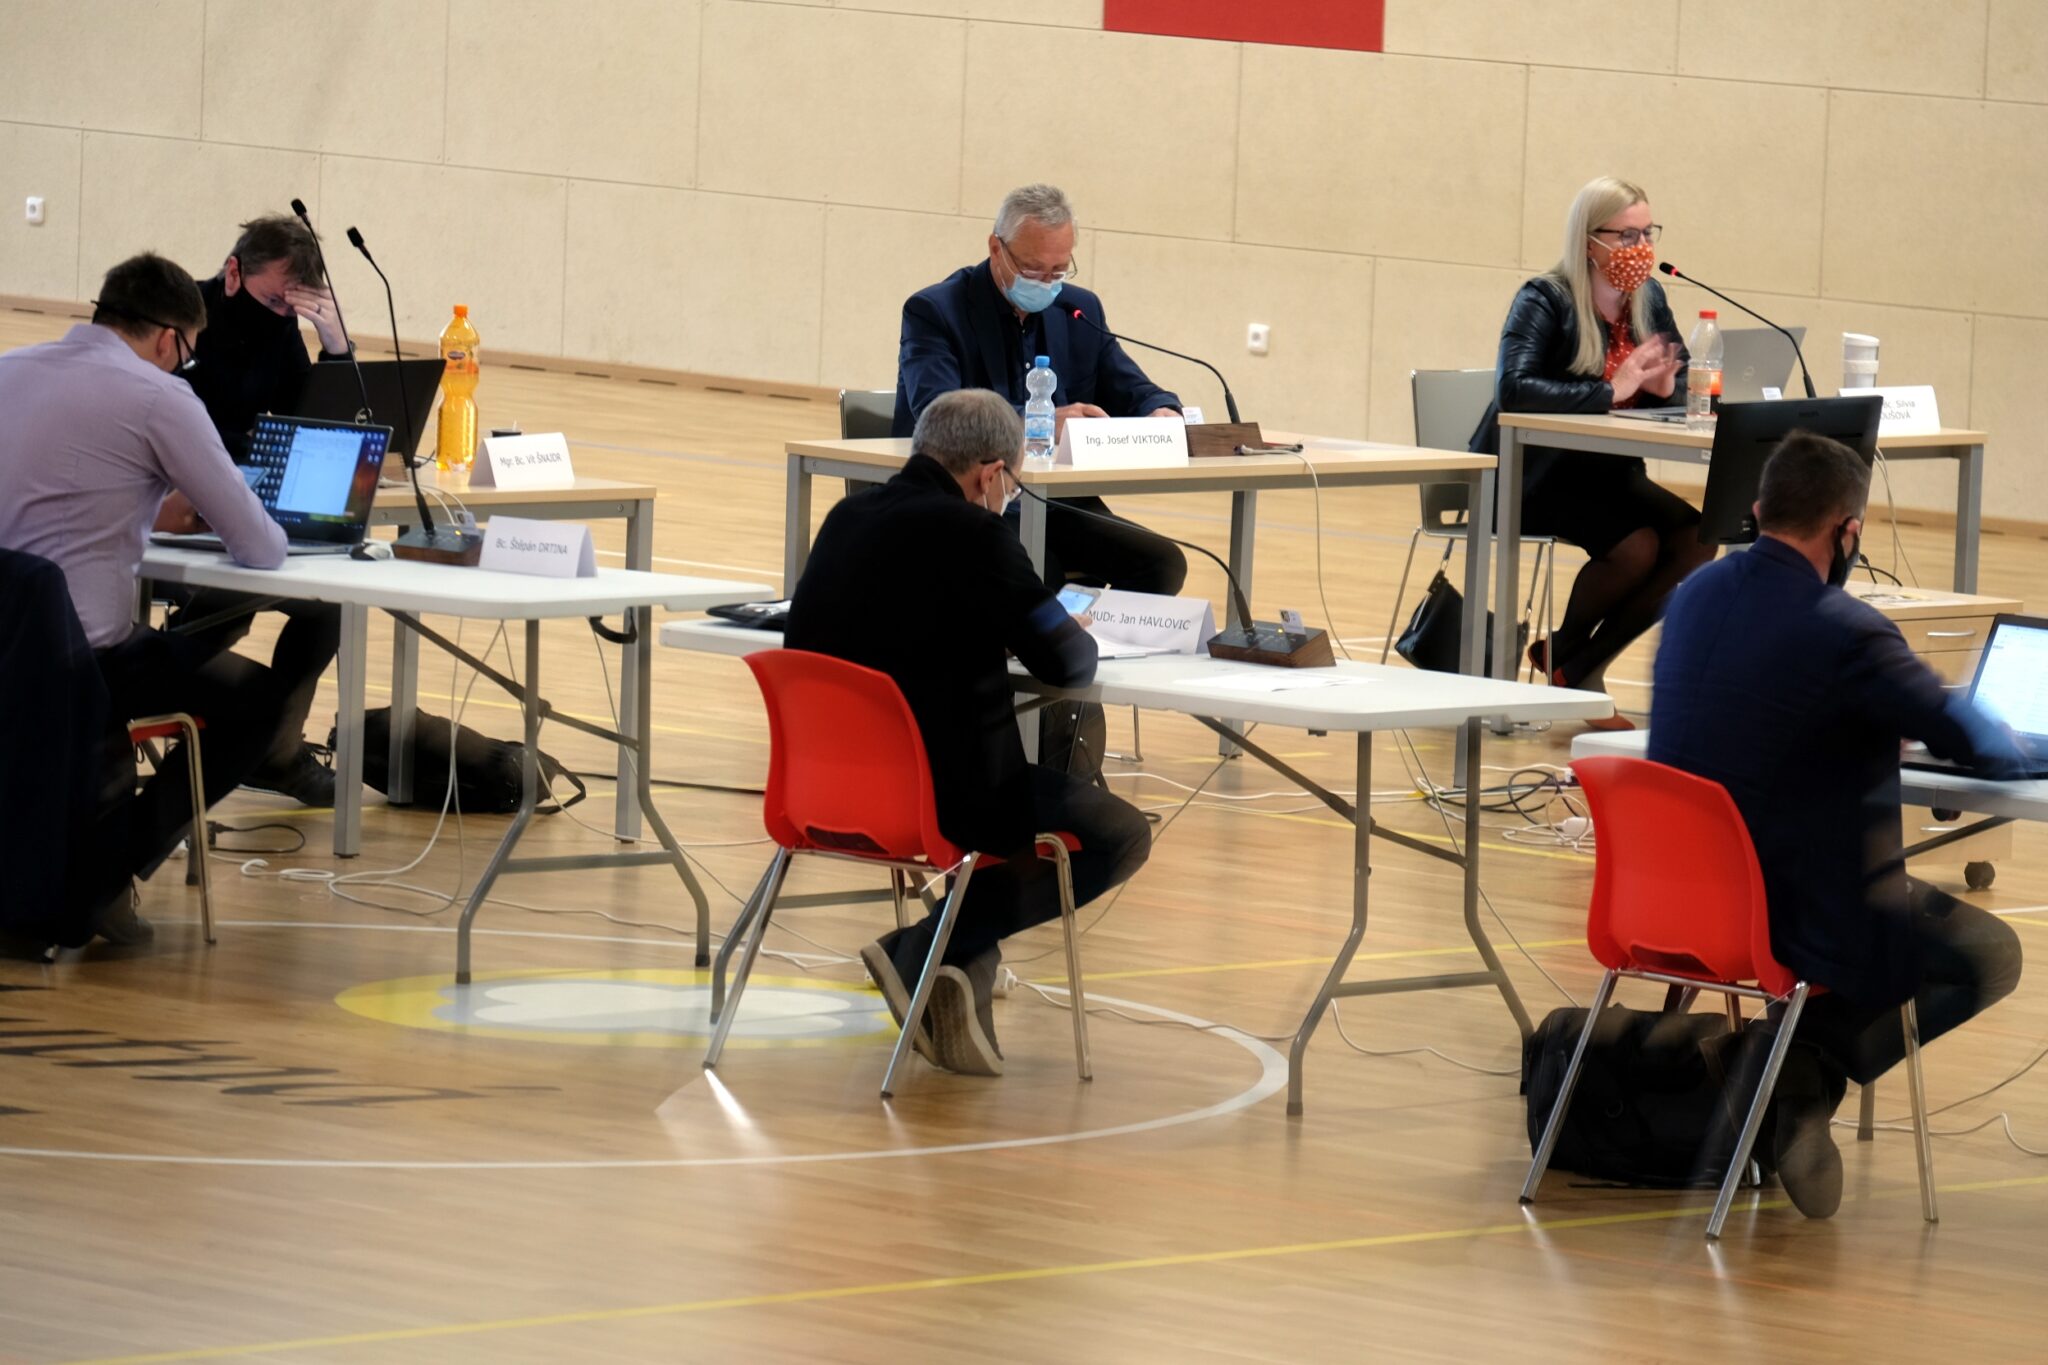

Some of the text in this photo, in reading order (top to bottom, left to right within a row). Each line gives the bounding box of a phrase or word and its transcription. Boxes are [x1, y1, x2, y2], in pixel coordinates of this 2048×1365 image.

[1086, 434, 1174, 447] Ing. Josef VIKTORA
[538, 542, 568, 554] DRTINA
[1089, 609, 1192, 631] MUDr. Jan HAVLOVIC
